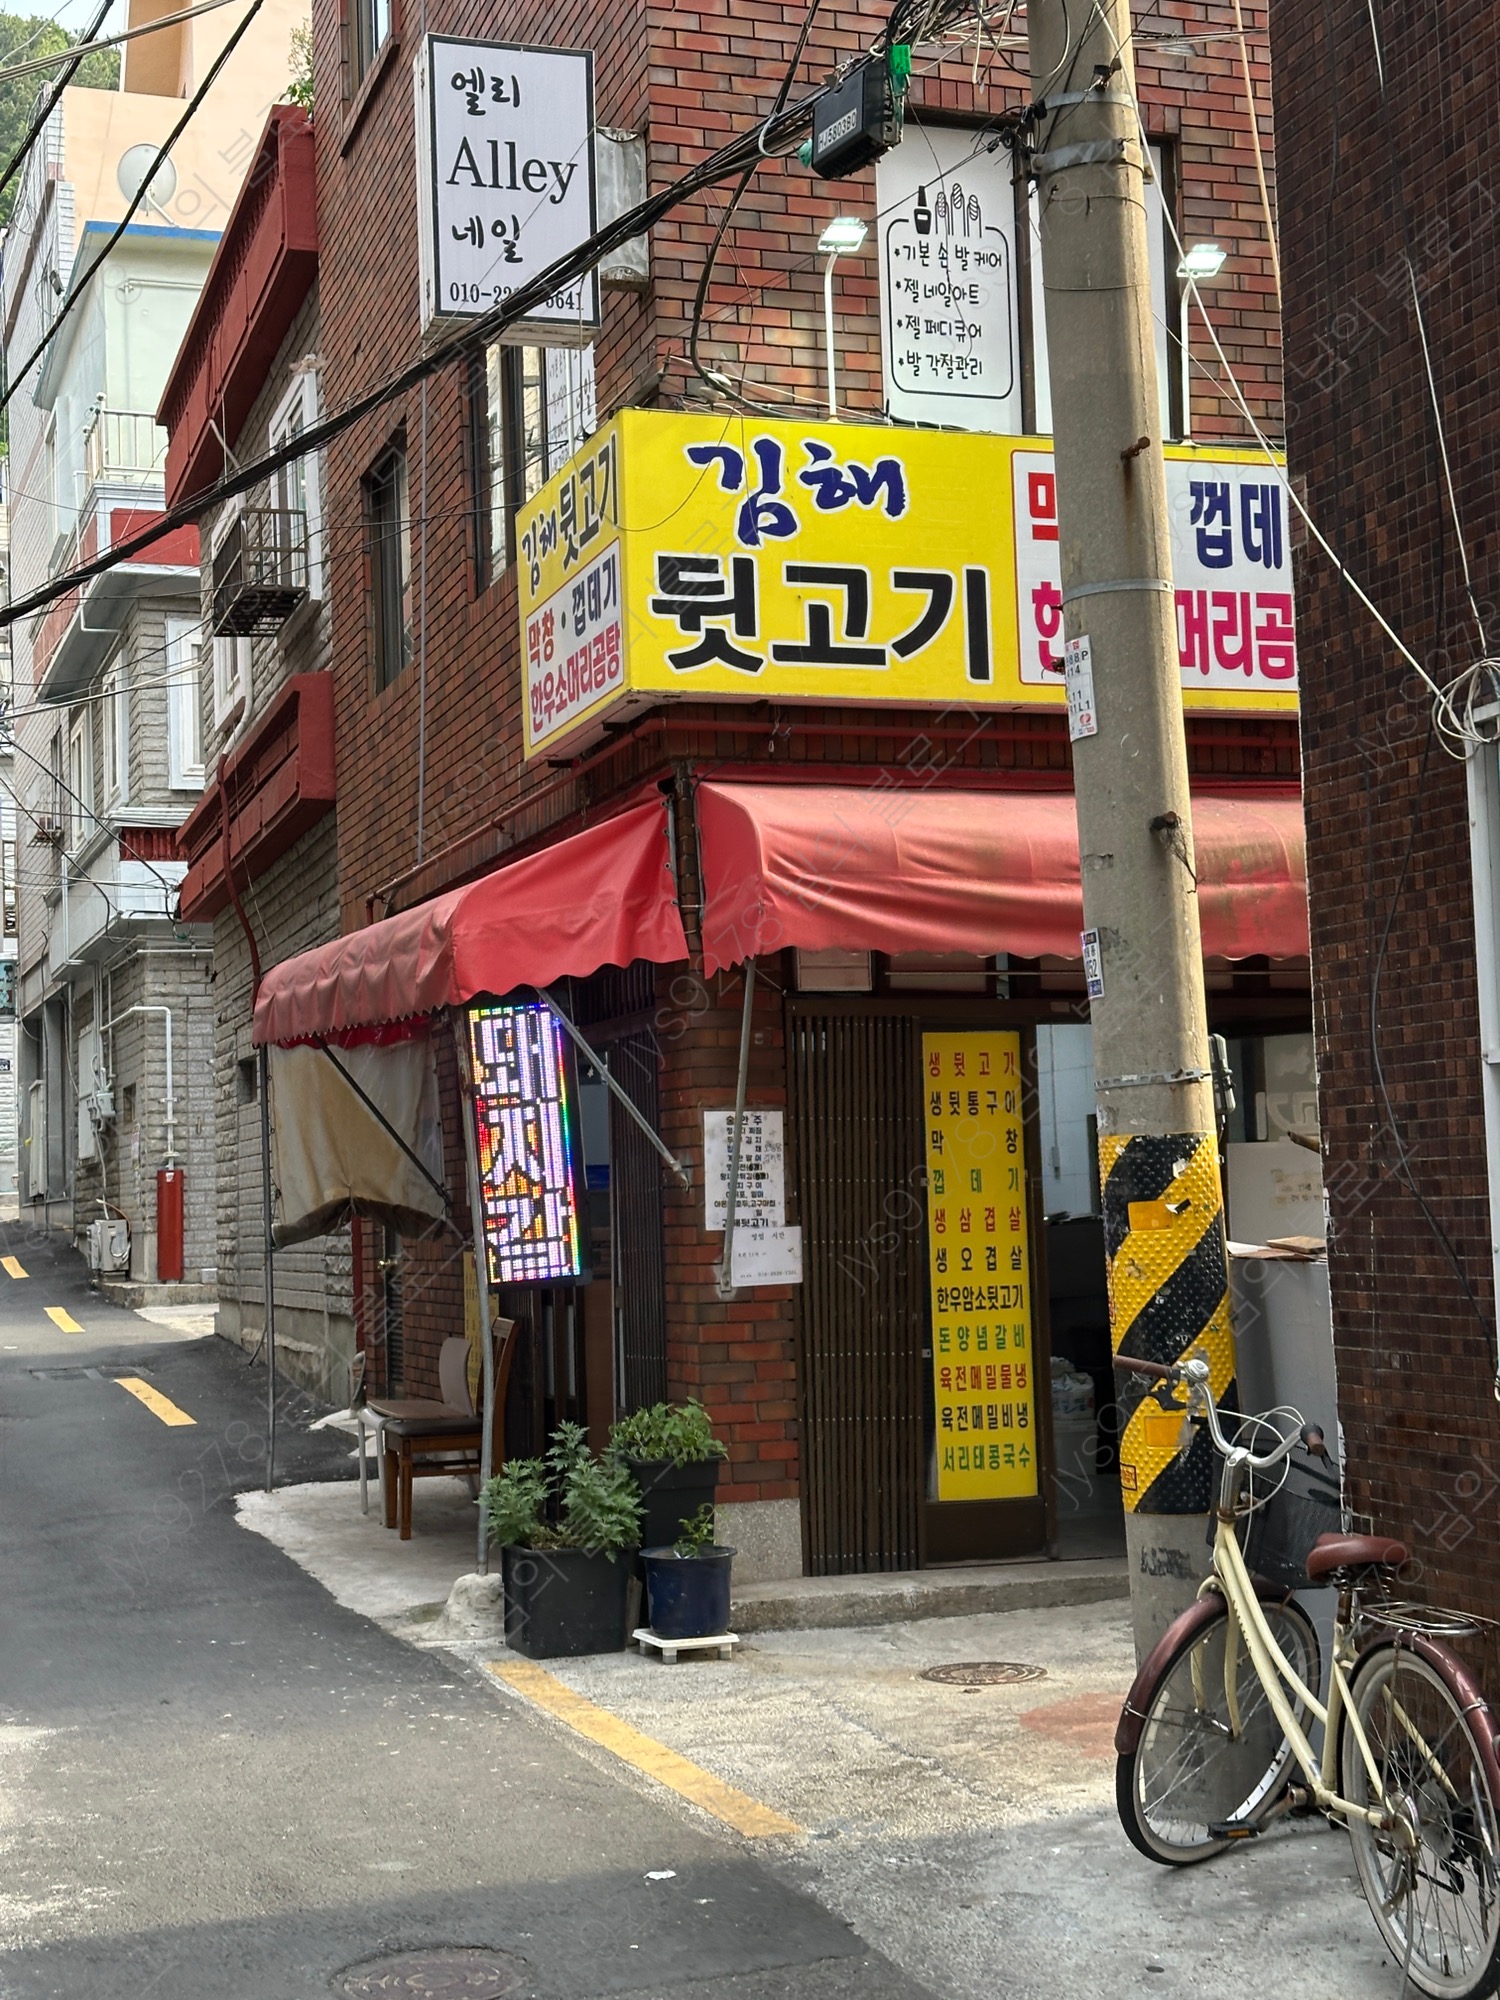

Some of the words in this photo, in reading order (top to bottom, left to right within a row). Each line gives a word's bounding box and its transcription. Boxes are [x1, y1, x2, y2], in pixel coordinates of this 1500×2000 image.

[450, 66, 521, 116] 엘리
[445, 136, 578, 204] Alley
[451, 214, 523, 263] 네일
[903, 240, 930, 267] 기본
[955, 245, 970, 271] 발
[974, 251, 1002, 267] 케어
[904, 278, 919, 303] 젤
[905, 314, 920, 340] 젤
[924, 319, 982, 343] 페디큐어
[906, 350, 922, 377] 발
[926, 353, 982, 380] 각질관리
[559, 433, 619, 572] 뒷고기
[687, 438, 906, 546] 김해
[528, 607, 555, 668] 막창
[571, 553, 617, 637] 껍데기
[651, 555, 990, 681] 뒷고기
[530, 620, 621, 734] 한우소머리곰탕
[937, 1285, 1024, 1313] 한우암소뒷고기
